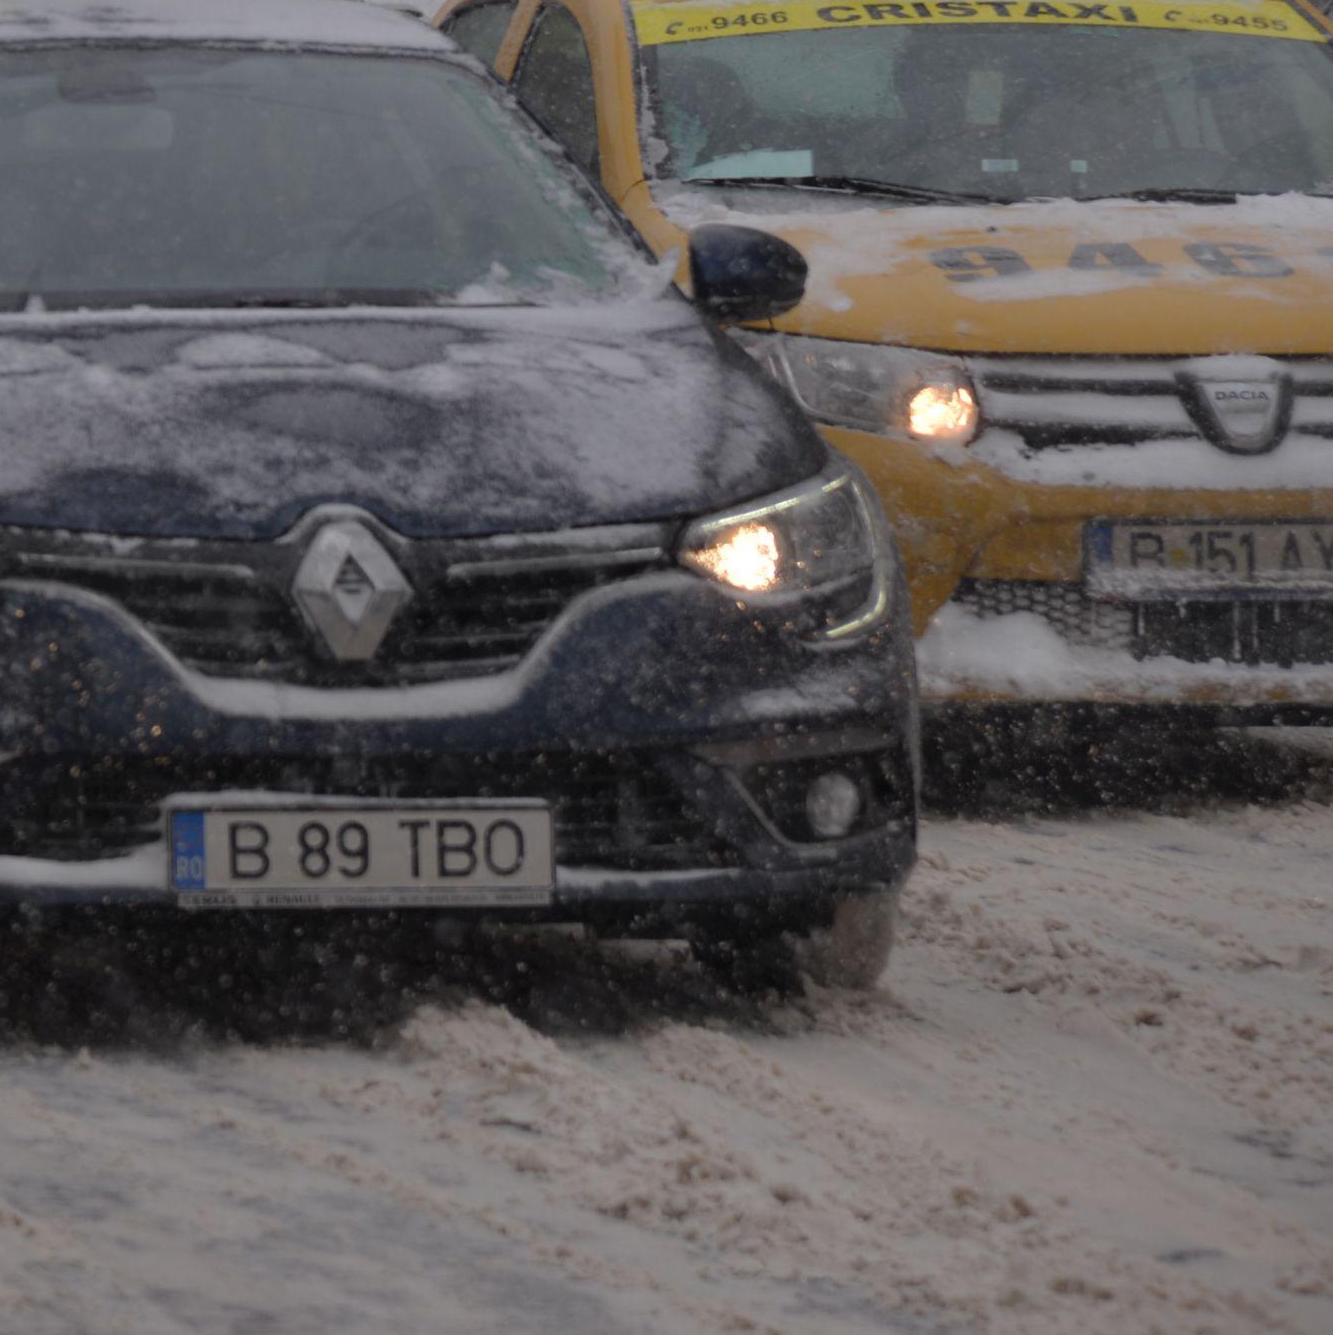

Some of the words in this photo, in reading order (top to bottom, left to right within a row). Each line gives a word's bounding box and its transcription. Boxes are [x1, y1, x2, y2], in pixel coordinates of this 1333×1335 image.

[711, 11, 788, 30] 9466
[817, 1, 1138, 23] CRISTAXI
[1211, 13, 1288, 32] 9455
[929, 241, 1333, 282] 946
[1215, 390, 1269, 401] DACIA
[1189, 531, 1254, 577] 151
[228, 820, 271, 880] B
[298, 820, 370, 879] 89
[399, 818, 526, 878] TBO
